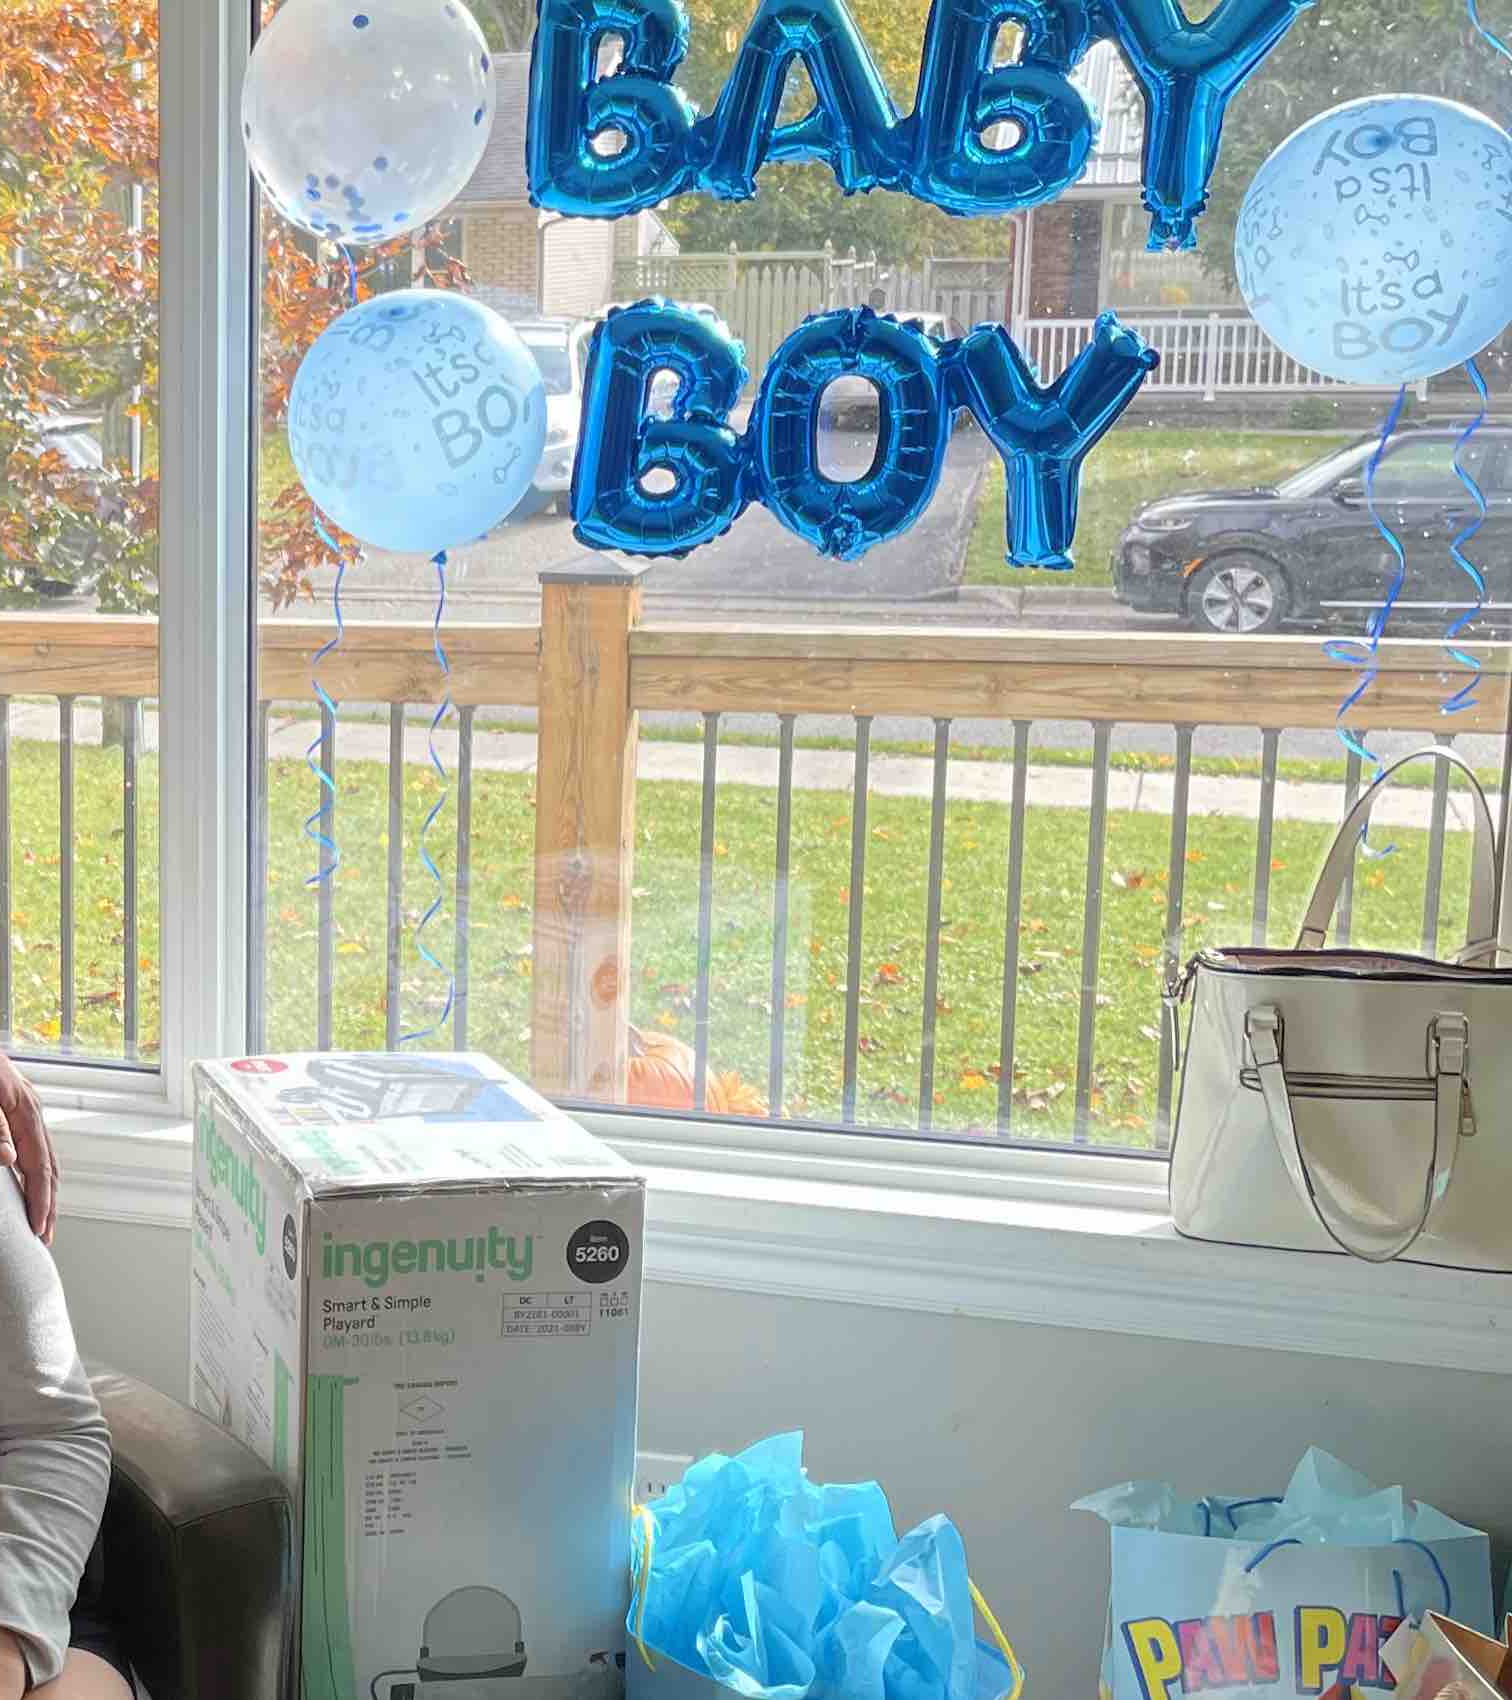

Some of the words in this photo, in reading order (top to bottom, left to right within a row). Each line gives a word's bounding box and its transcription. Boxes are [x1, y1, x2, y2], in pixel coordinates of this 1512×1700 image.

[527, 0, 1316, 253] BABY
[1312, 116, 1439, 177] BOY
[1332, 293, 1469, 361] BOY
[570, 297, 1161, 570] BOY
[322, 1225, 533, 1289] ingenuity
[575, 1245, 620, 1263] 5260
[322, 1299, 368, 1313] Smart
[371, 1298, 380, 1311] &
[383, 1296, 433, 1314] Simple
[322, 1314, 376, 1333] Playard
[1121, 1609, 1281, 1700] PAW
